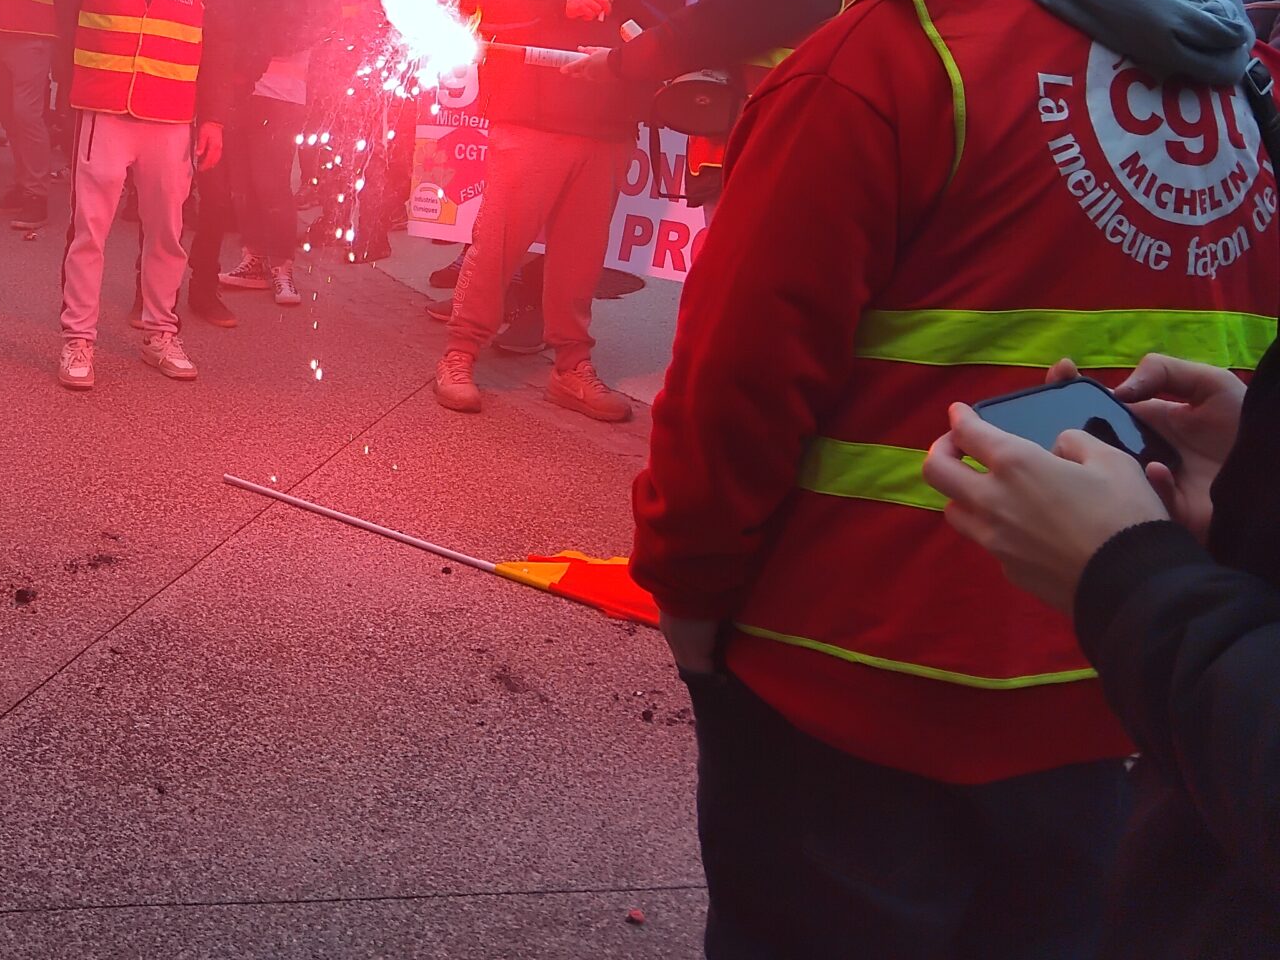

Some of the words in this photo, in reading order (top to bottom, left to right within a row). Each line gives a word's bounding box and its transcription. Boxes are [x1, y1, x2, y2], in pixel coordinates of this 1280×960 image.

[1037, 71, 1073, 123] La
[454, 143, 489, 161] CGT
[1047, 133, 1172, 271] meilleure
[1119, 151, 1249, 217] MICHELIN
[1186, 225, 1251, 281] façon
